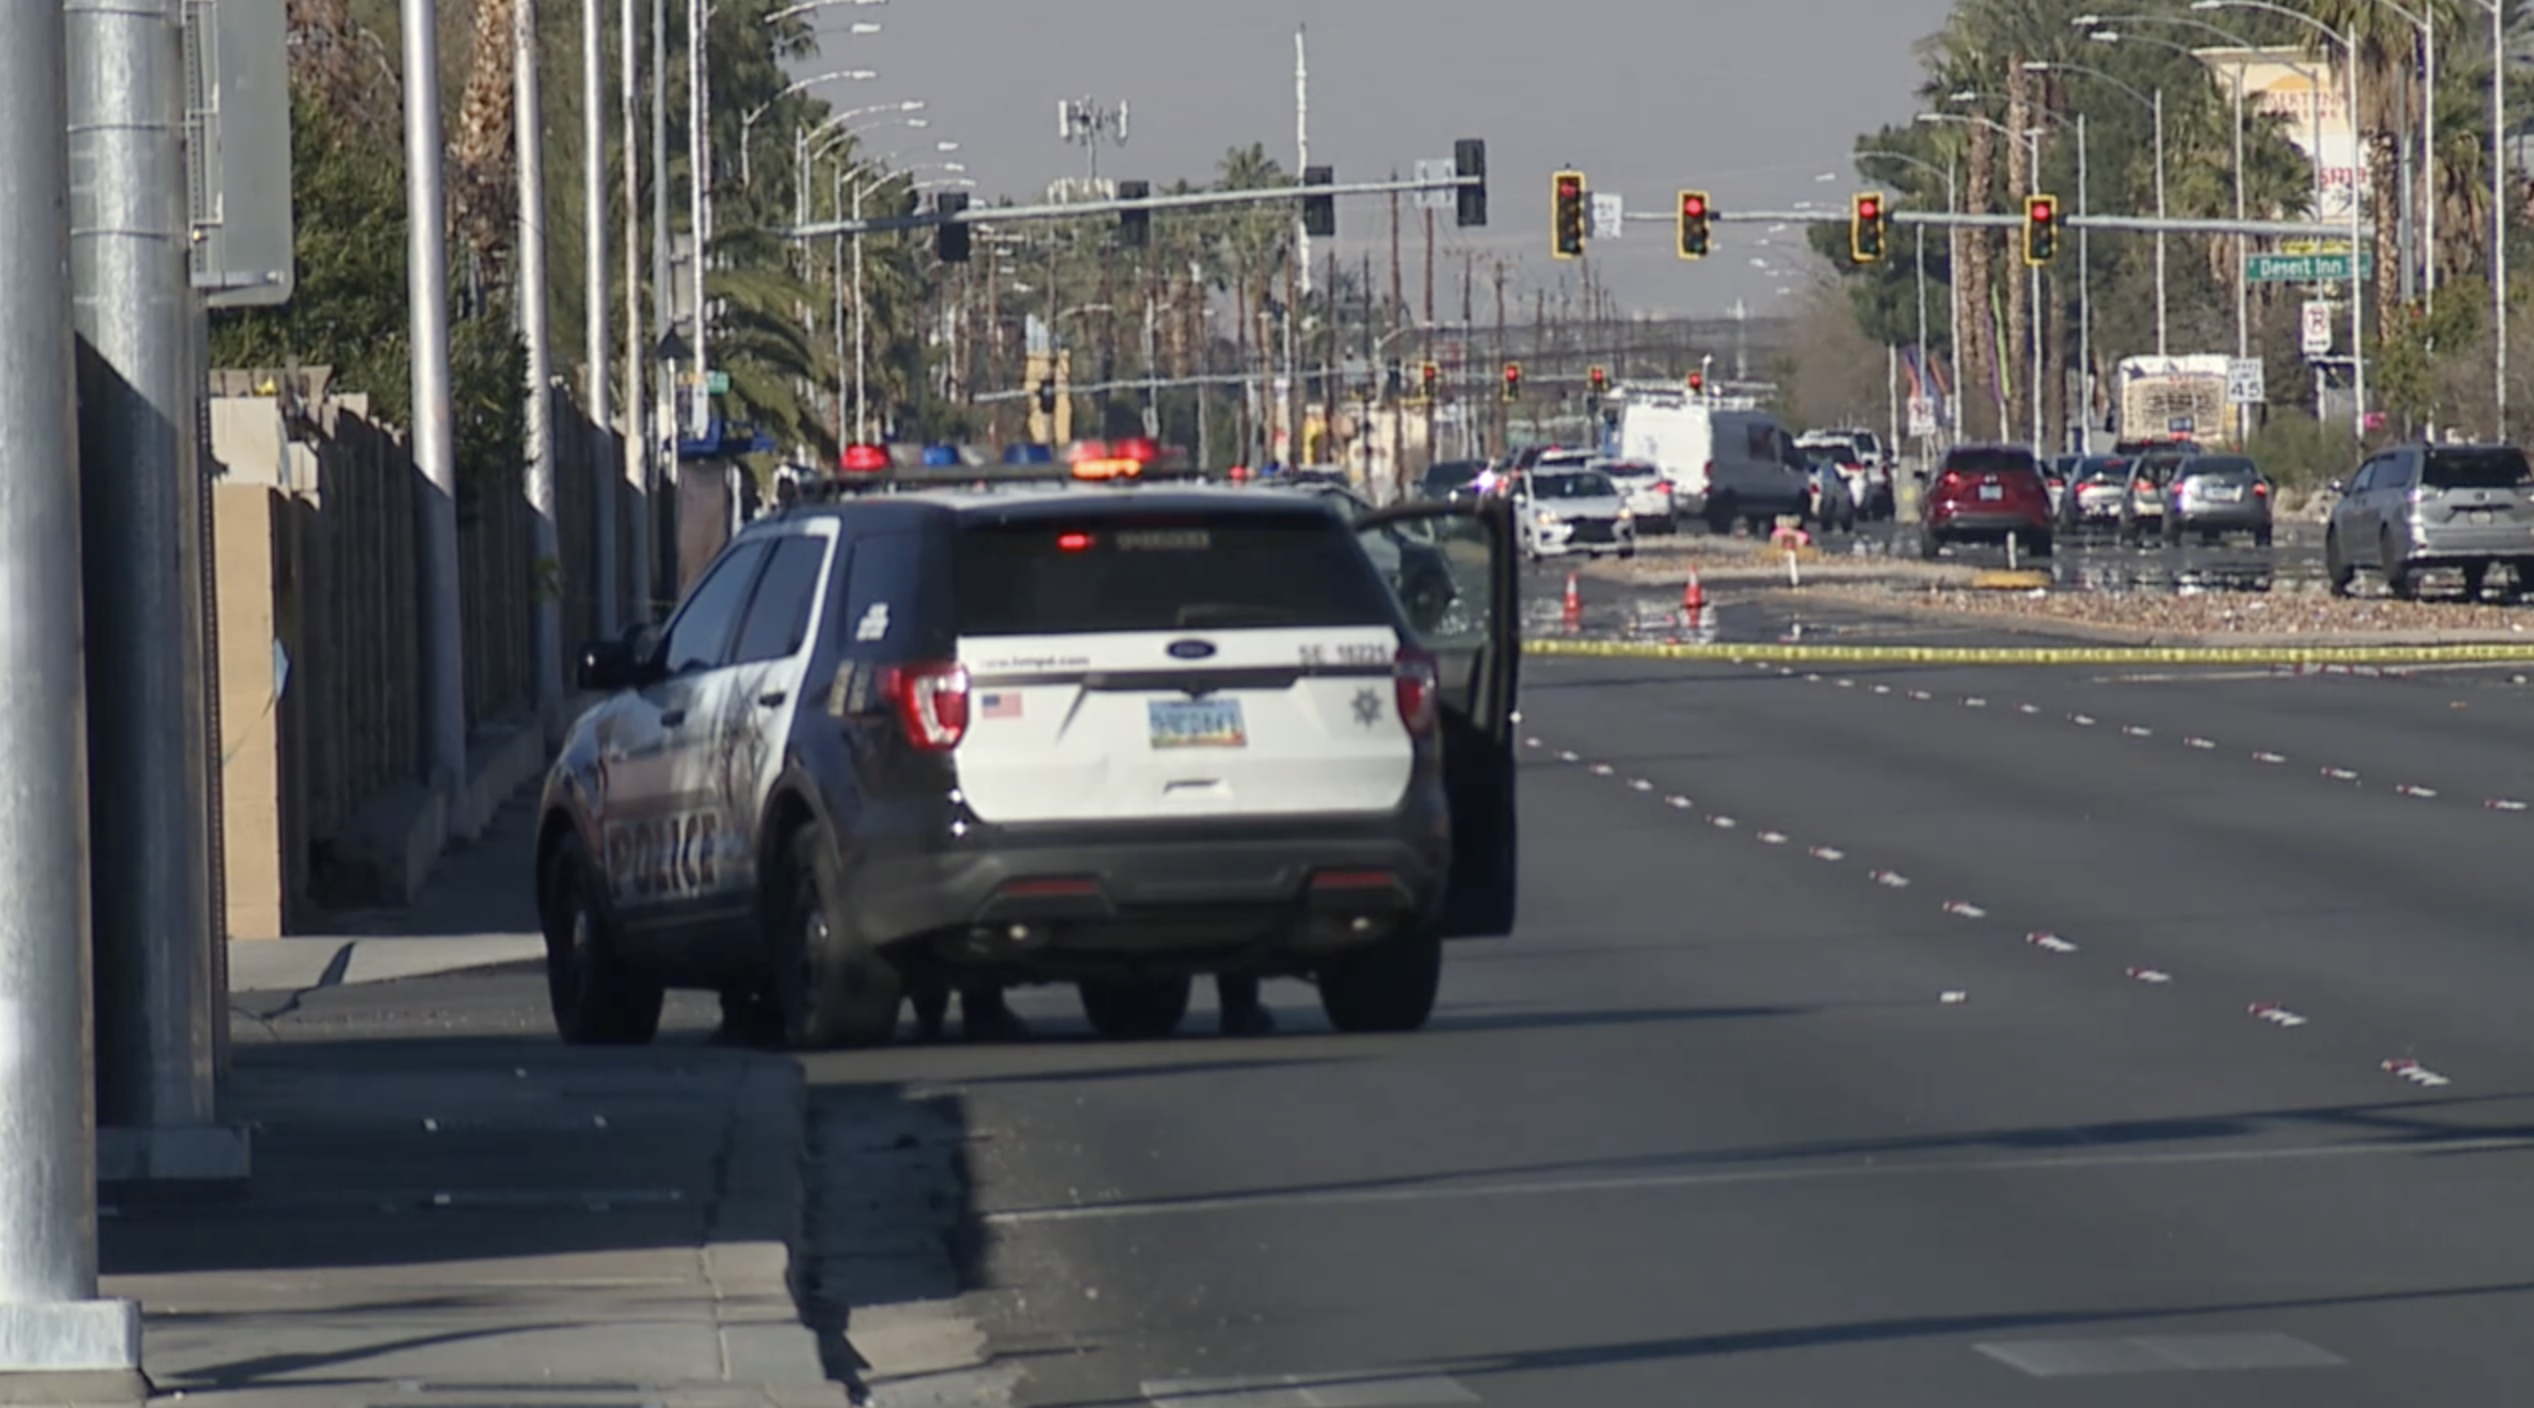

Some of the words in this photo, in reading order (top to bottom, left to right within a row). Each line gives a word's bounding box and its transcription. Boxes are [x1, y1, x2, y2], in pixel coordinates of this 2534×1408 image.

[2260, 256, 2311, 277] Desert
[2315, 257, 2342, 275] Inn
[2230, 382, 2261, 398] 45
[604, 806, 722, 907] POLICE
